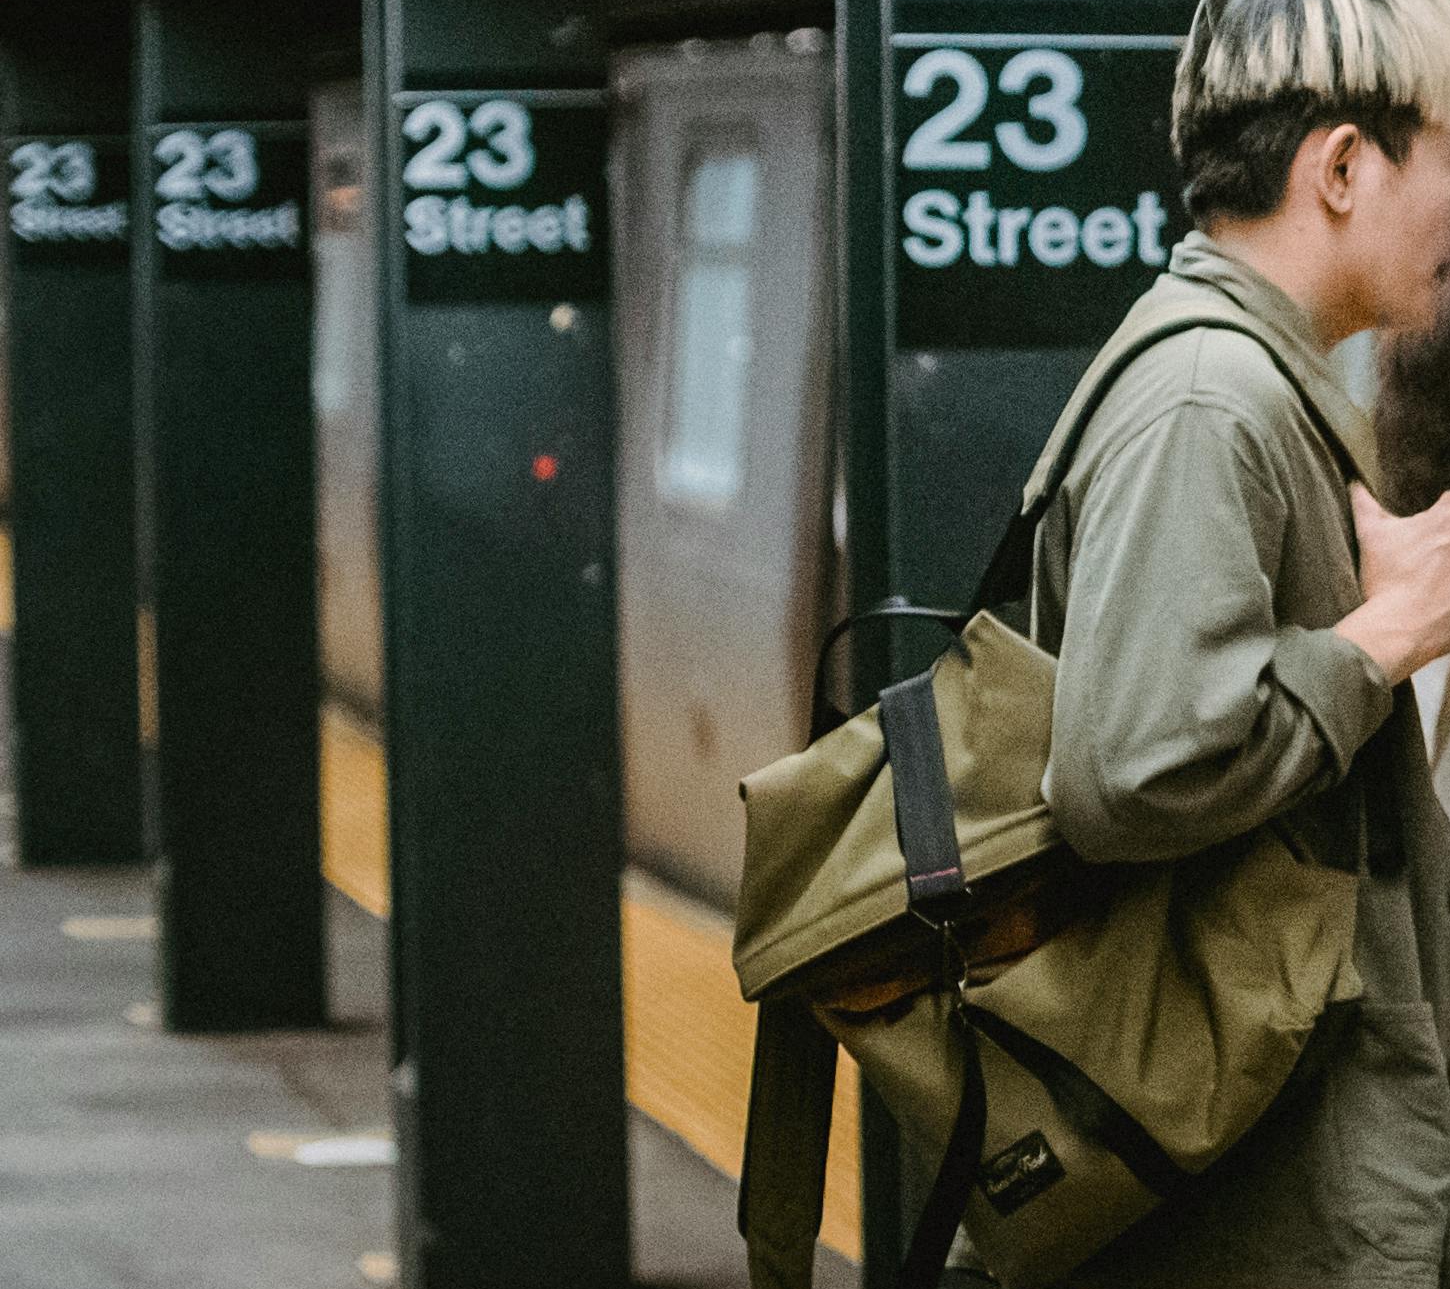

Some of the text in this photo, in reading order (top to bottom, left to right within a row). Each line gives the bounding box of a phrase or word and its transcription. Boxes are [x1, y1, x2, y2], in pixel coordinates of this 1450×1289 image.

[402, 99, 533, 188] 23
[902, 47, 1089, 170] 23
[10, 142, 95, 199] 23
[154, 129, 256, 201] 23
[402, 193, 588, 254] Street
[903, 189, 1167, 267] Street
